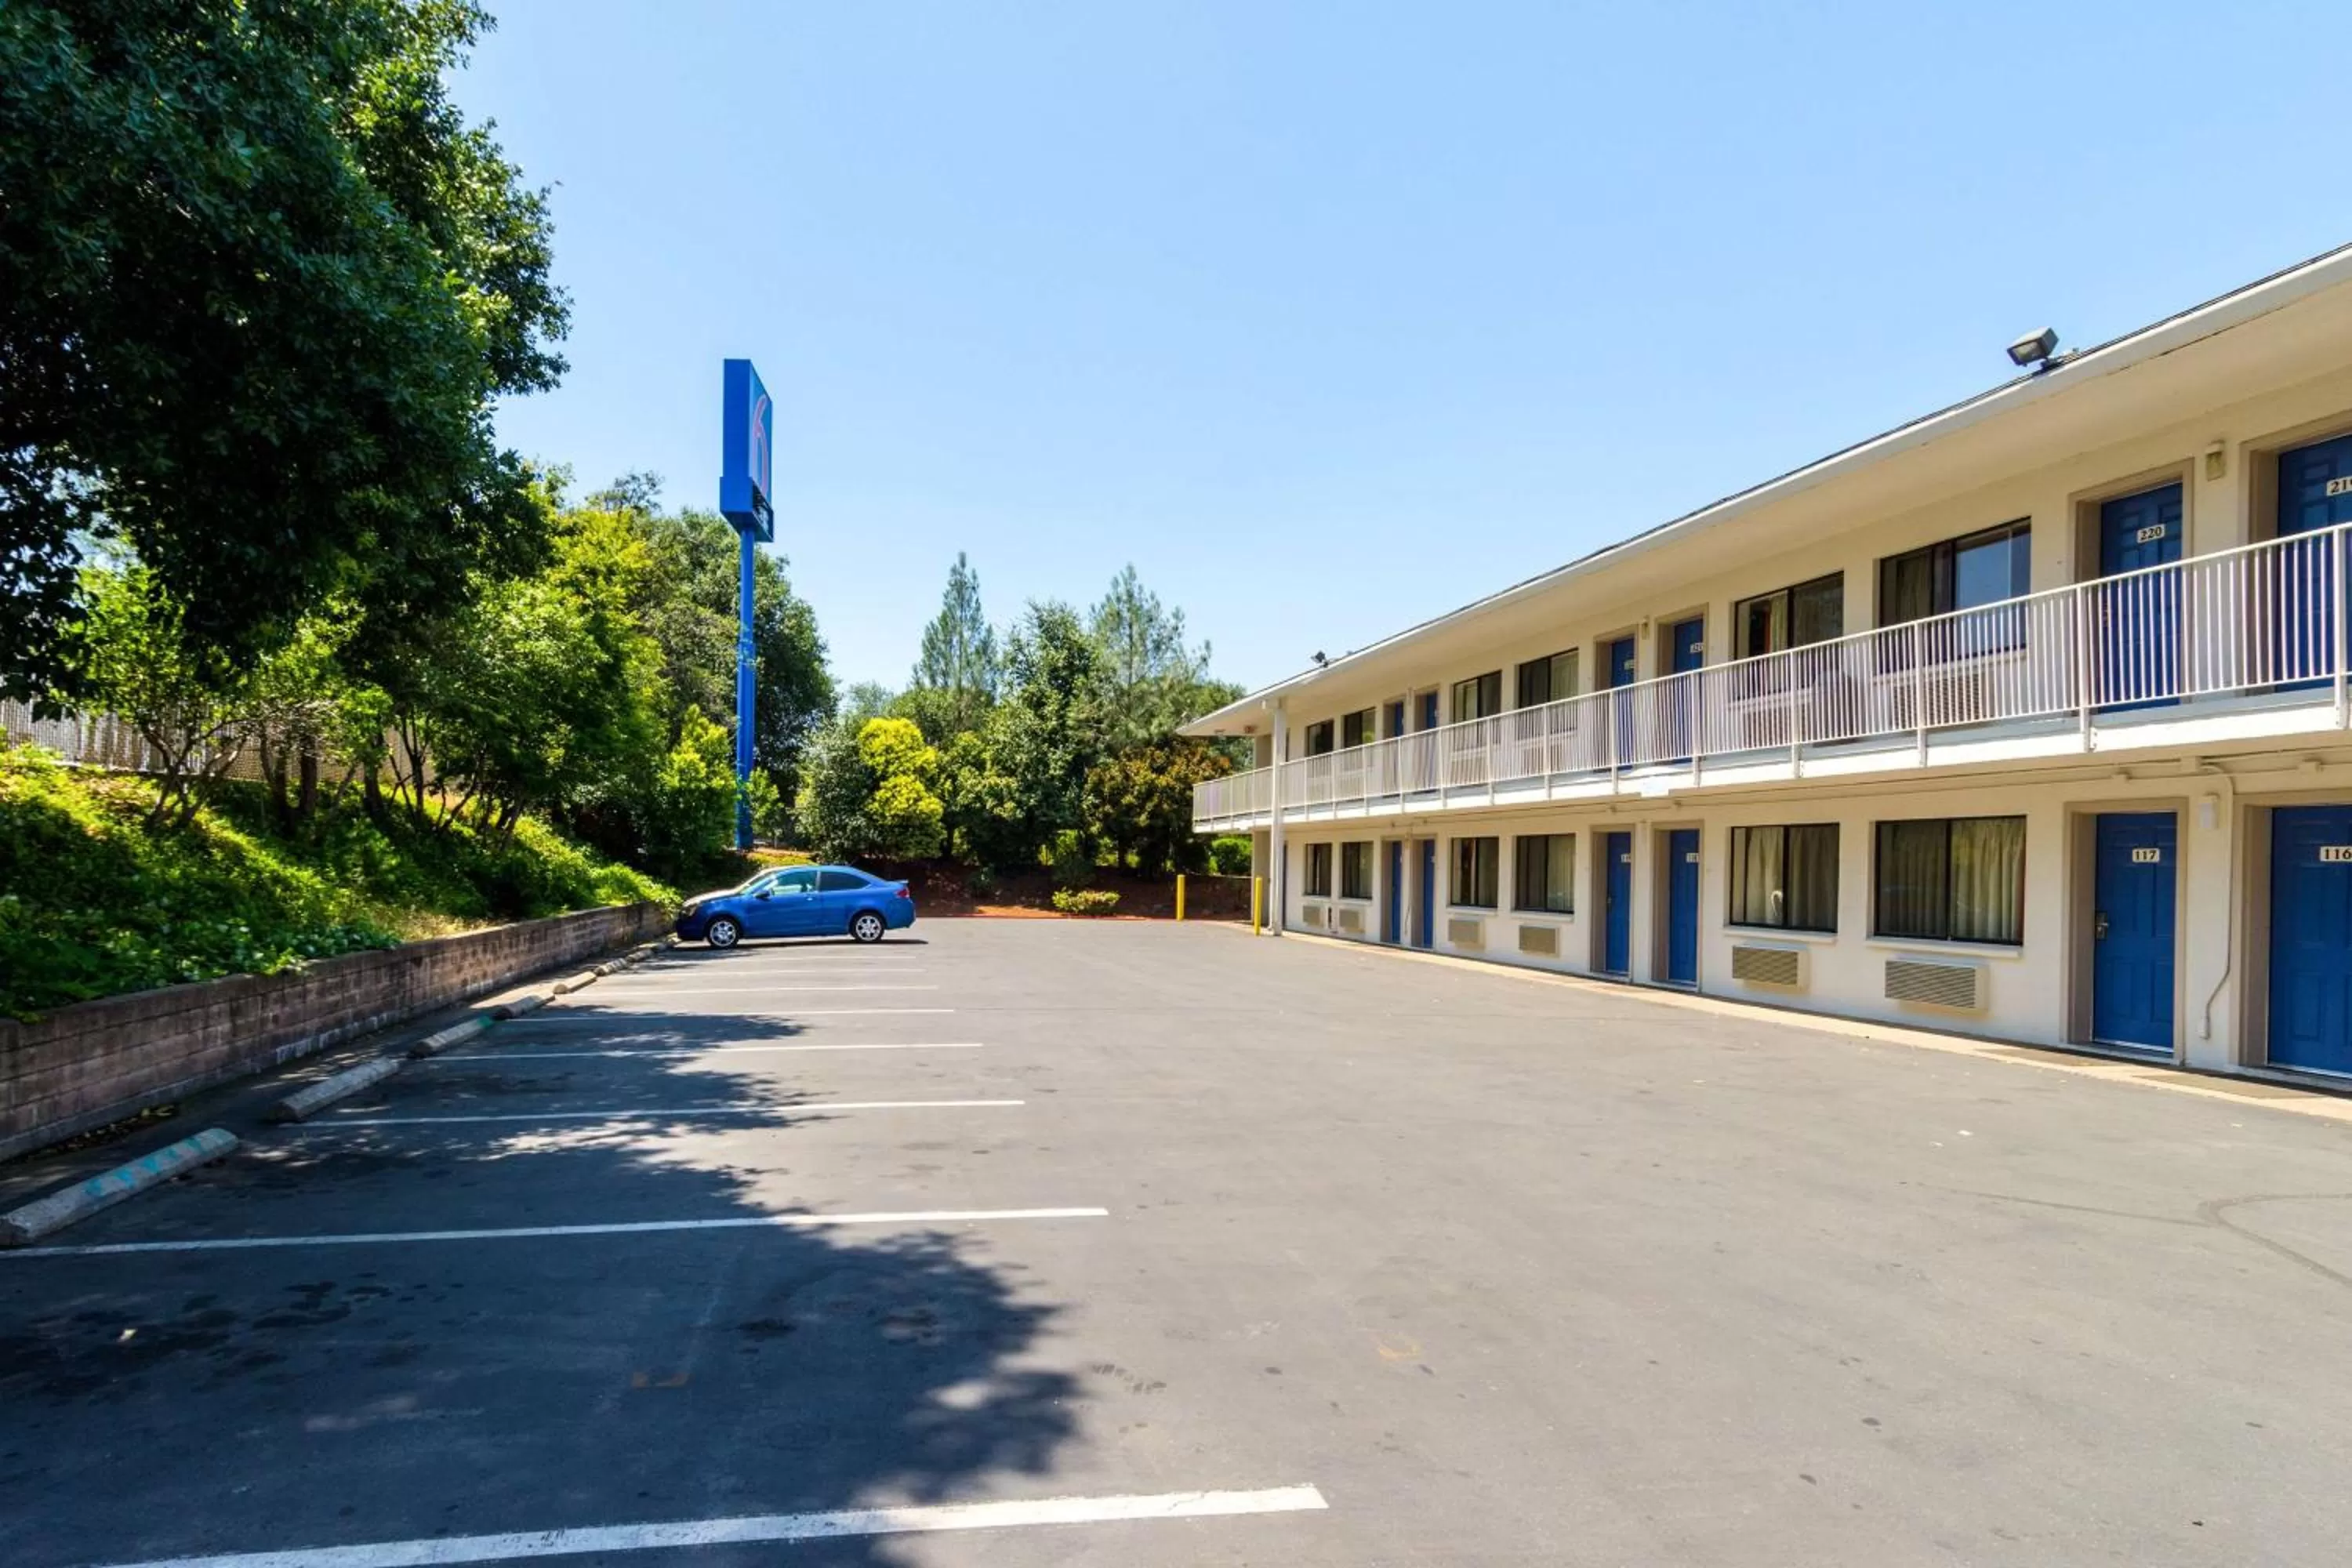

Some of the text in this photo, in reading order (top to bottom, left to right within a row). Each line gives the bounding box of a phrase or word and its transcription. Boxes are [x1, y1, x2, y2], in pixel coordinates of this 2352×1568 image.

[2140, 526, 2161, 540] 220
[2135, 849, 2157, 860] 117
[2325, 848, 2352, 860] 116
